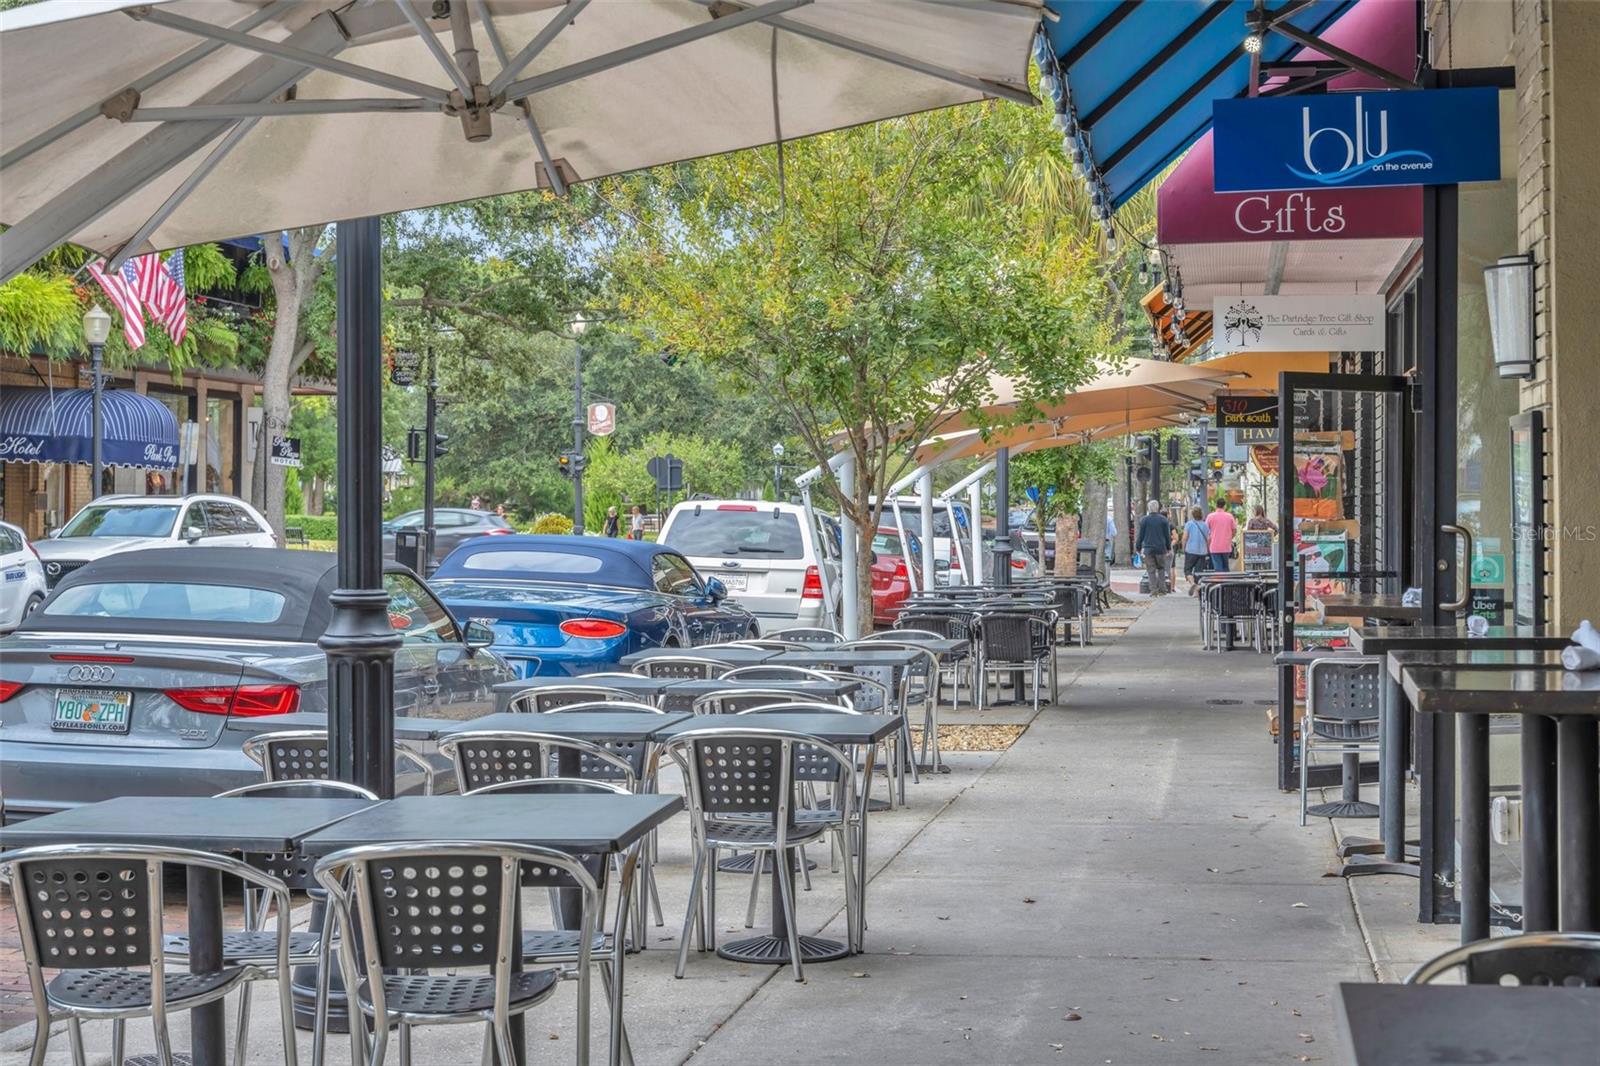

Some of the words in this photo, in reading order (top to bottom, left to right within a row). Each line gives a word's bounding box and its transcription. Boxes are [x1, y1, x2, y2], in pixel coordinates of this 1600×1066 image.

[1302, 95, 1388, 175] blu
[1385, 163, 1399, 171] the
[1400, 162, 1433, 170] avenue
[1235, 193, 1346, 234] Gifts
[1266, 314, 1280, 323] The
[1282, 314, 1317, 325] Partridge
[1319, 314, 1336, 322] Tree
[1337, 313, 1352, 322] Gift
[1353, 313, 1375, 325] Shop
[1292, 327, 1315, 336] Cards
[1328, 327, 1347, 336] Gifts
[1224, 413, 1245, 425] park
[1246, 413, 1271, 423] south
[0, 436, 45, 455] Hotel
[1472, 600, 1497, 610] Uber
